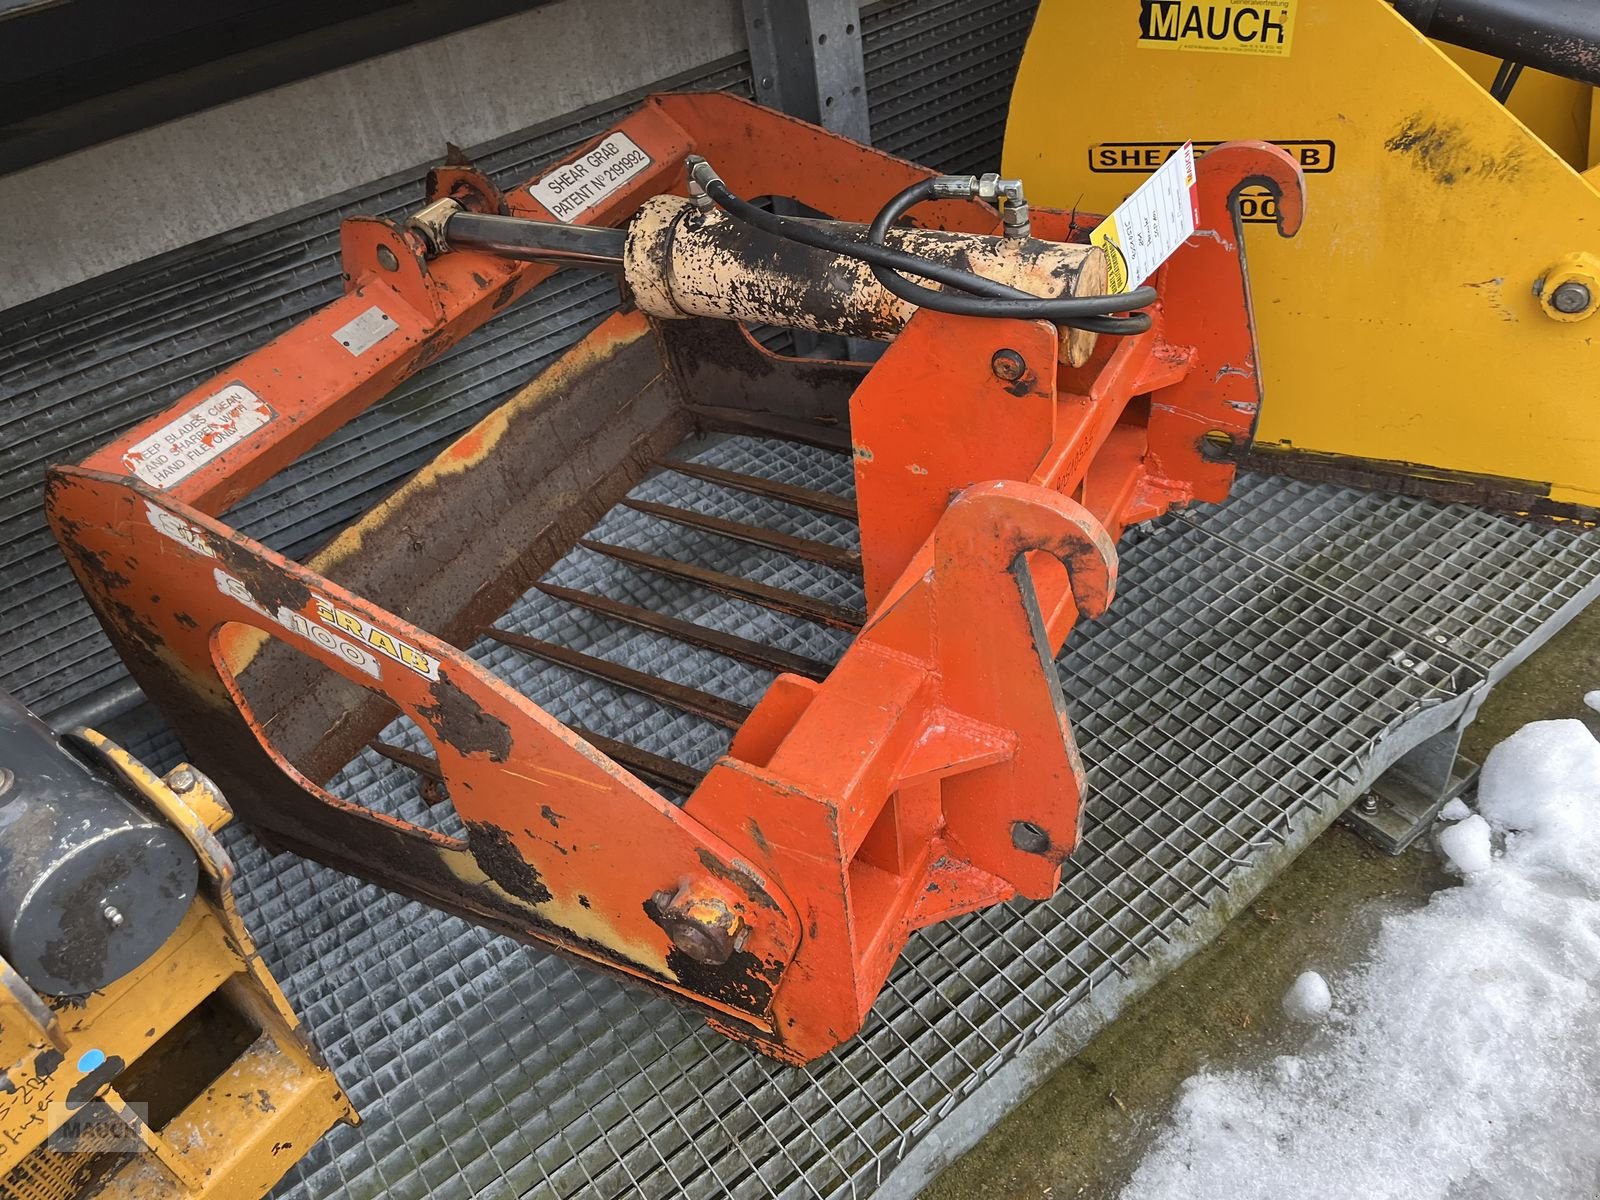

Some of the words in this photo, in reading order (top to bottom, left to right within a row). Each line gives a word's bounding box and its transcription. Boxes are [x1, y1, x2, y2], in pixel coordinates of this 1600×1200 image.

[1148, 4, 1284, 44] MAUCH
[548, 164, 590, 194] SHEAR
[586, 142, 620, 168] GRAB
[552, 184, 595, 218] PATENT
[605, 150, 646, 182] 2191992
[164, 414, 207, 444] BLADES
[207, 392, 243, 417] CLEAN
[145, 454, 168, 473] AND
[169, 423, 219, 457] SHARPEN
[153, 459, 186, 481] HAND
[187, 441, 210, 461] FILE
[213, 425, 239, 444] ONLY
